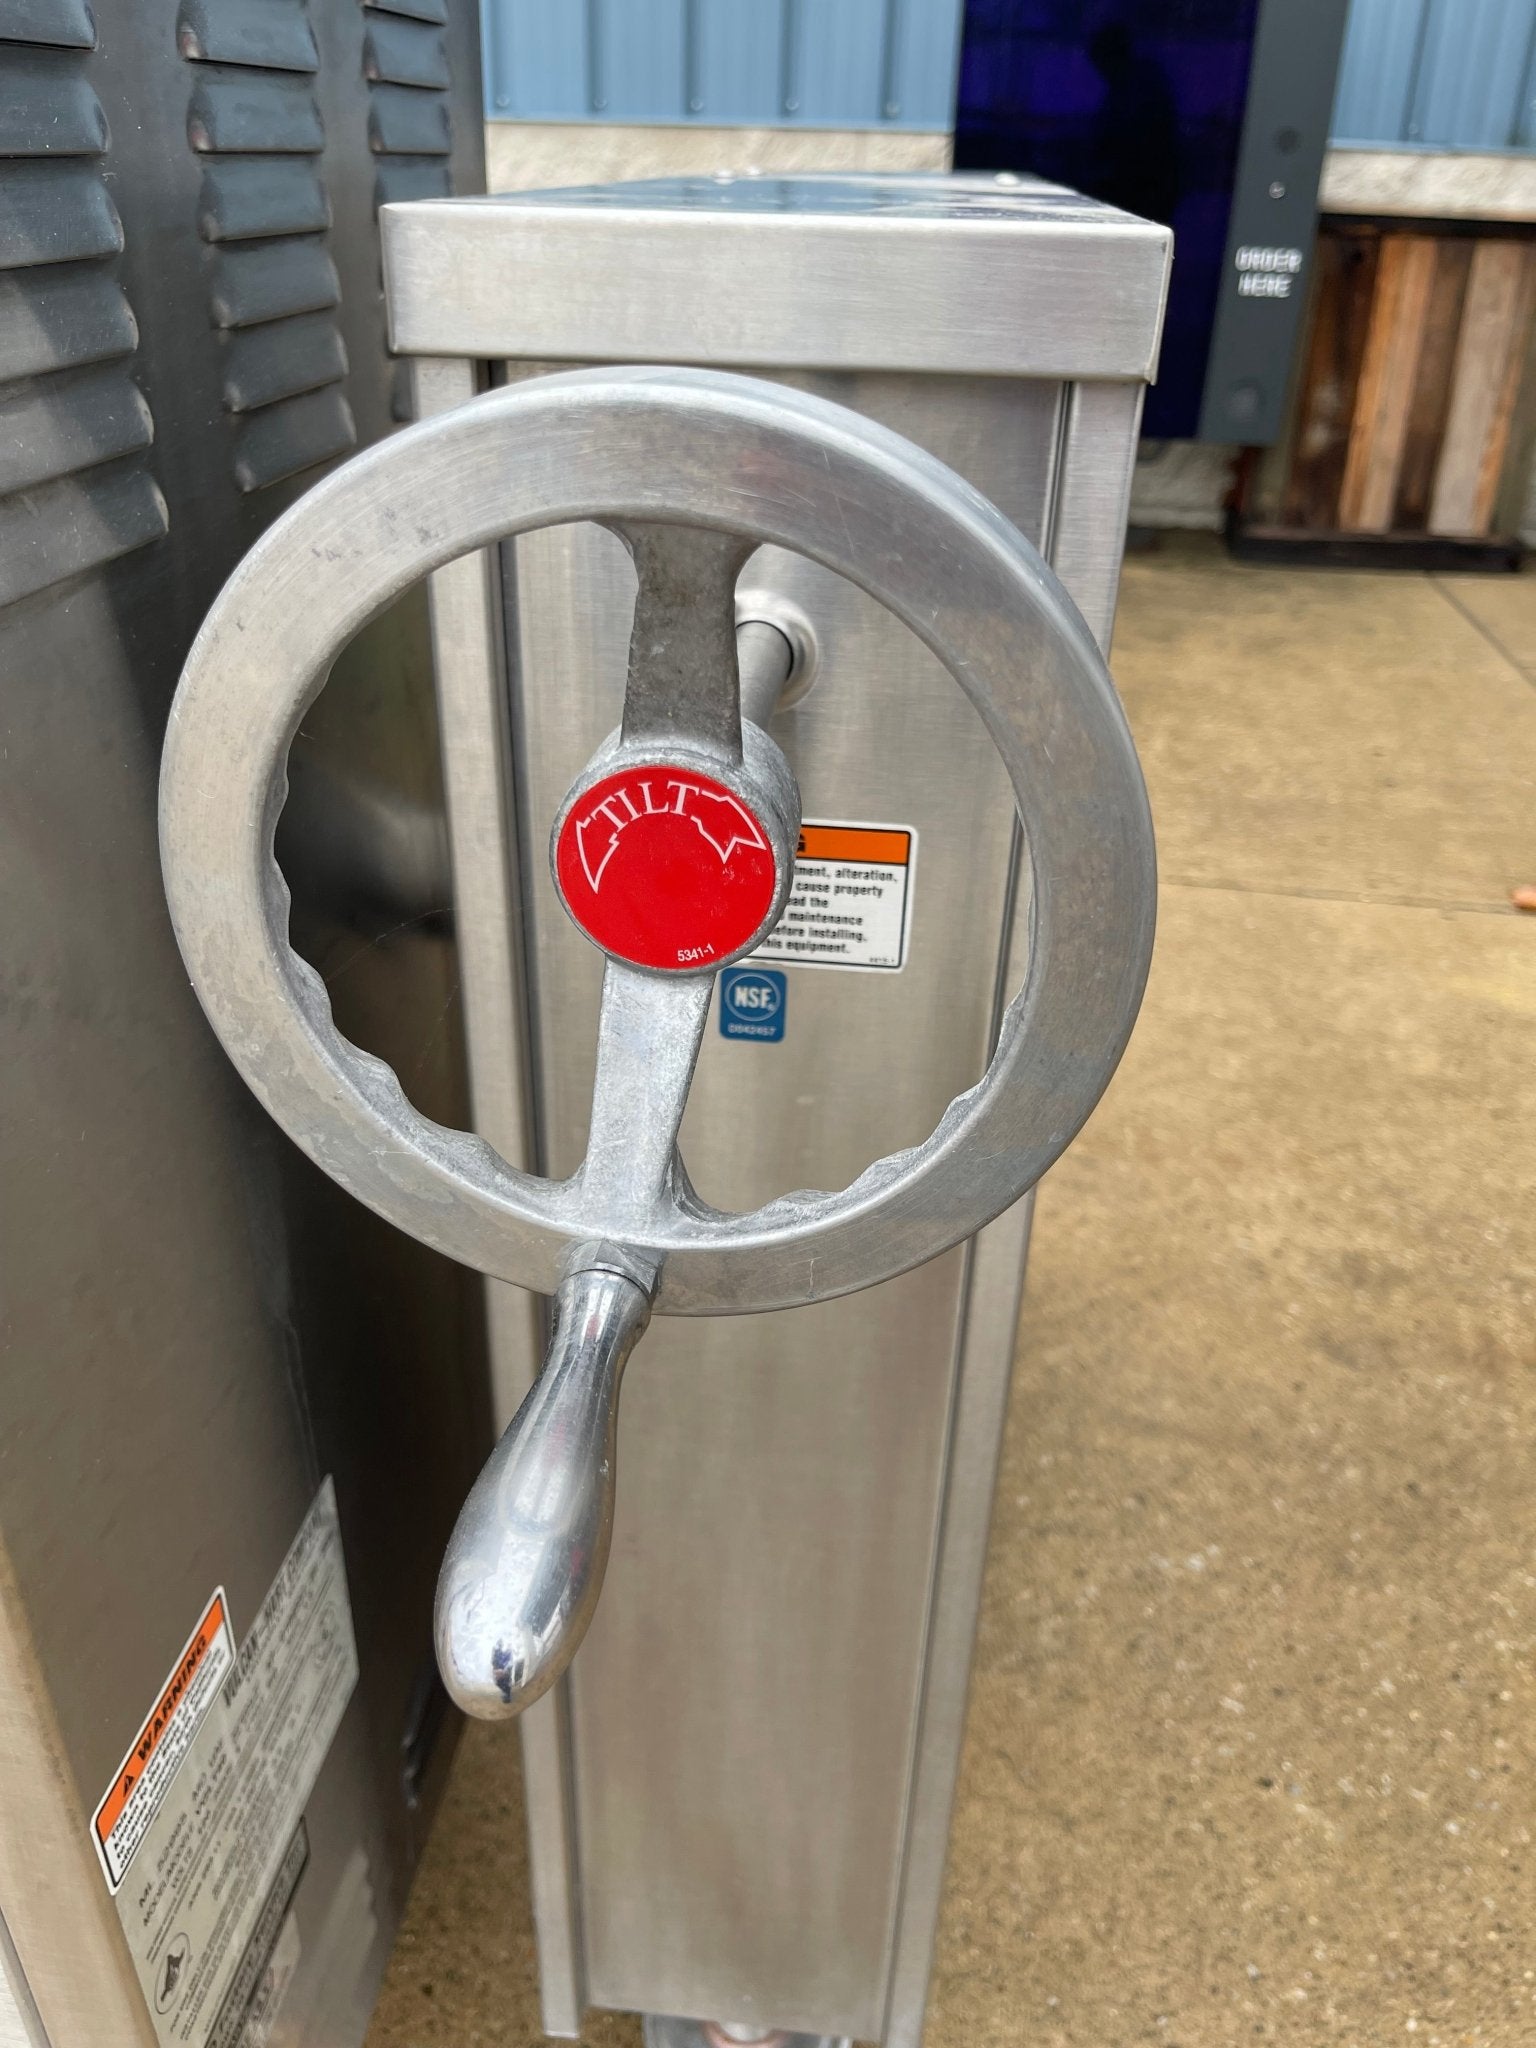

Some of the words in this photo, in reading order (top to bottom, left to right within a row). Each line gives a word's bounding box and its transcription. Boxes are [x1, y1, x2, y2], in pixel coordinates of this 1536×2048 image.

[1235, 247, 1302, 273] ORDER
[591, 781, 699, 833] TILT
[795, 882, 830, 894] cause
[833, 885, 883, 898] property
[810, 898, 829, 908] the
[788, 913, 864, 926] maintenance
[677, 943, 716, 962] 5341-1
[734, 986, 772, 1009] NSF
[137, 1634, 206, 1761] WARNING
[111, 1808, 127, 1841] This
[128, 1776, 144, 1808] area
[113, 1801, 138, 1850] known
[139, 1783, 147, 1801] to
[148, 1759, 160, 1783] the
[116, 1841, 125, 1861] to
[126, 1799, 147, 1842] cause
[119, 1829, 139, 1871] other
